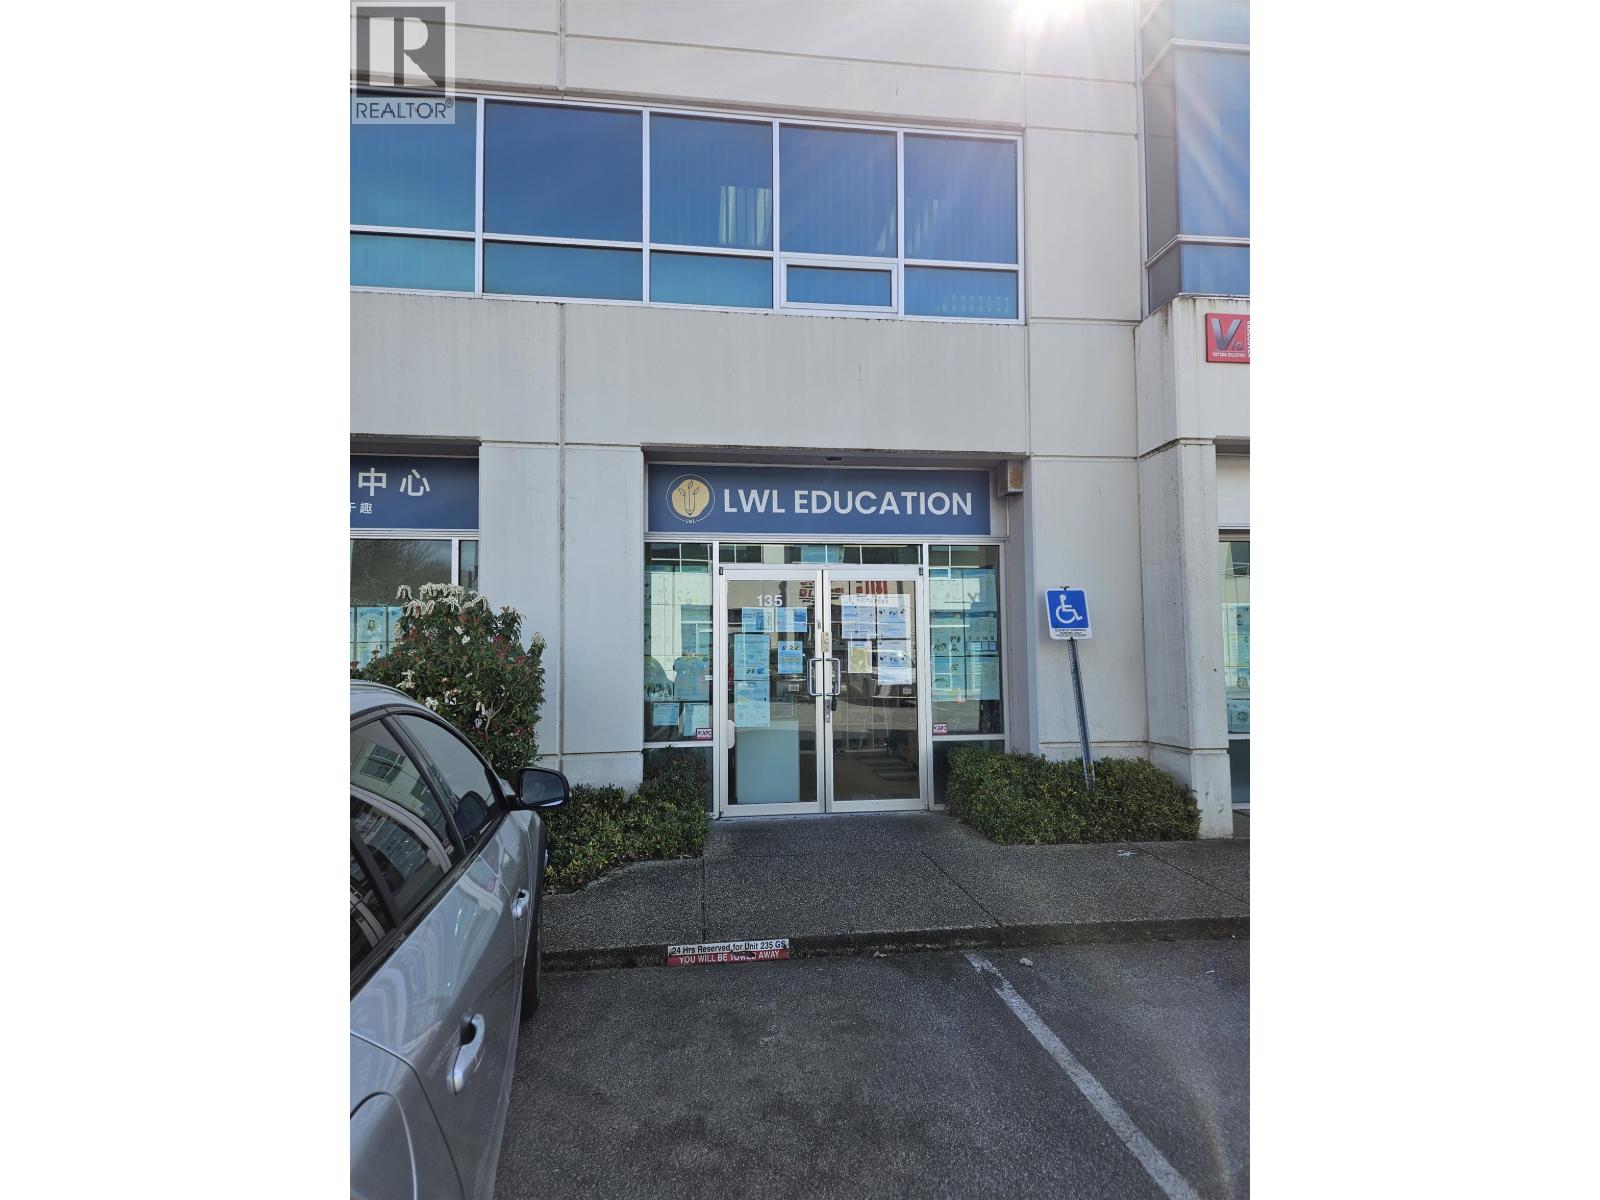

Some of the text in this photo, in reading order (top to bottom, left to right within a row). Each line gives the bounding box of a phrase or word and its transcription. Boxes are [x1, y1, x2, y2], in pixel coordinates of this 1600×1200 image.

[358, 467, 431, 497] 中心
[724, 488, 972, 516] LWL EDUCATION
[756, 594, 783, 607] 135
[672, 947, 681, 955] 24
[683, 946, 695, 954] Hrs
[697, 944, 731, 953] Reserved
[732, 942, 743, 951] for
[745, 941, 758, 950] Unit
[760, 941, 773, 950] 235
[679, 955, 696, 964] YOU
[697, 954, 716, 963] WILL
[717, 953, 728, 961] BE
[759, 950, 780, 959] AWAY
